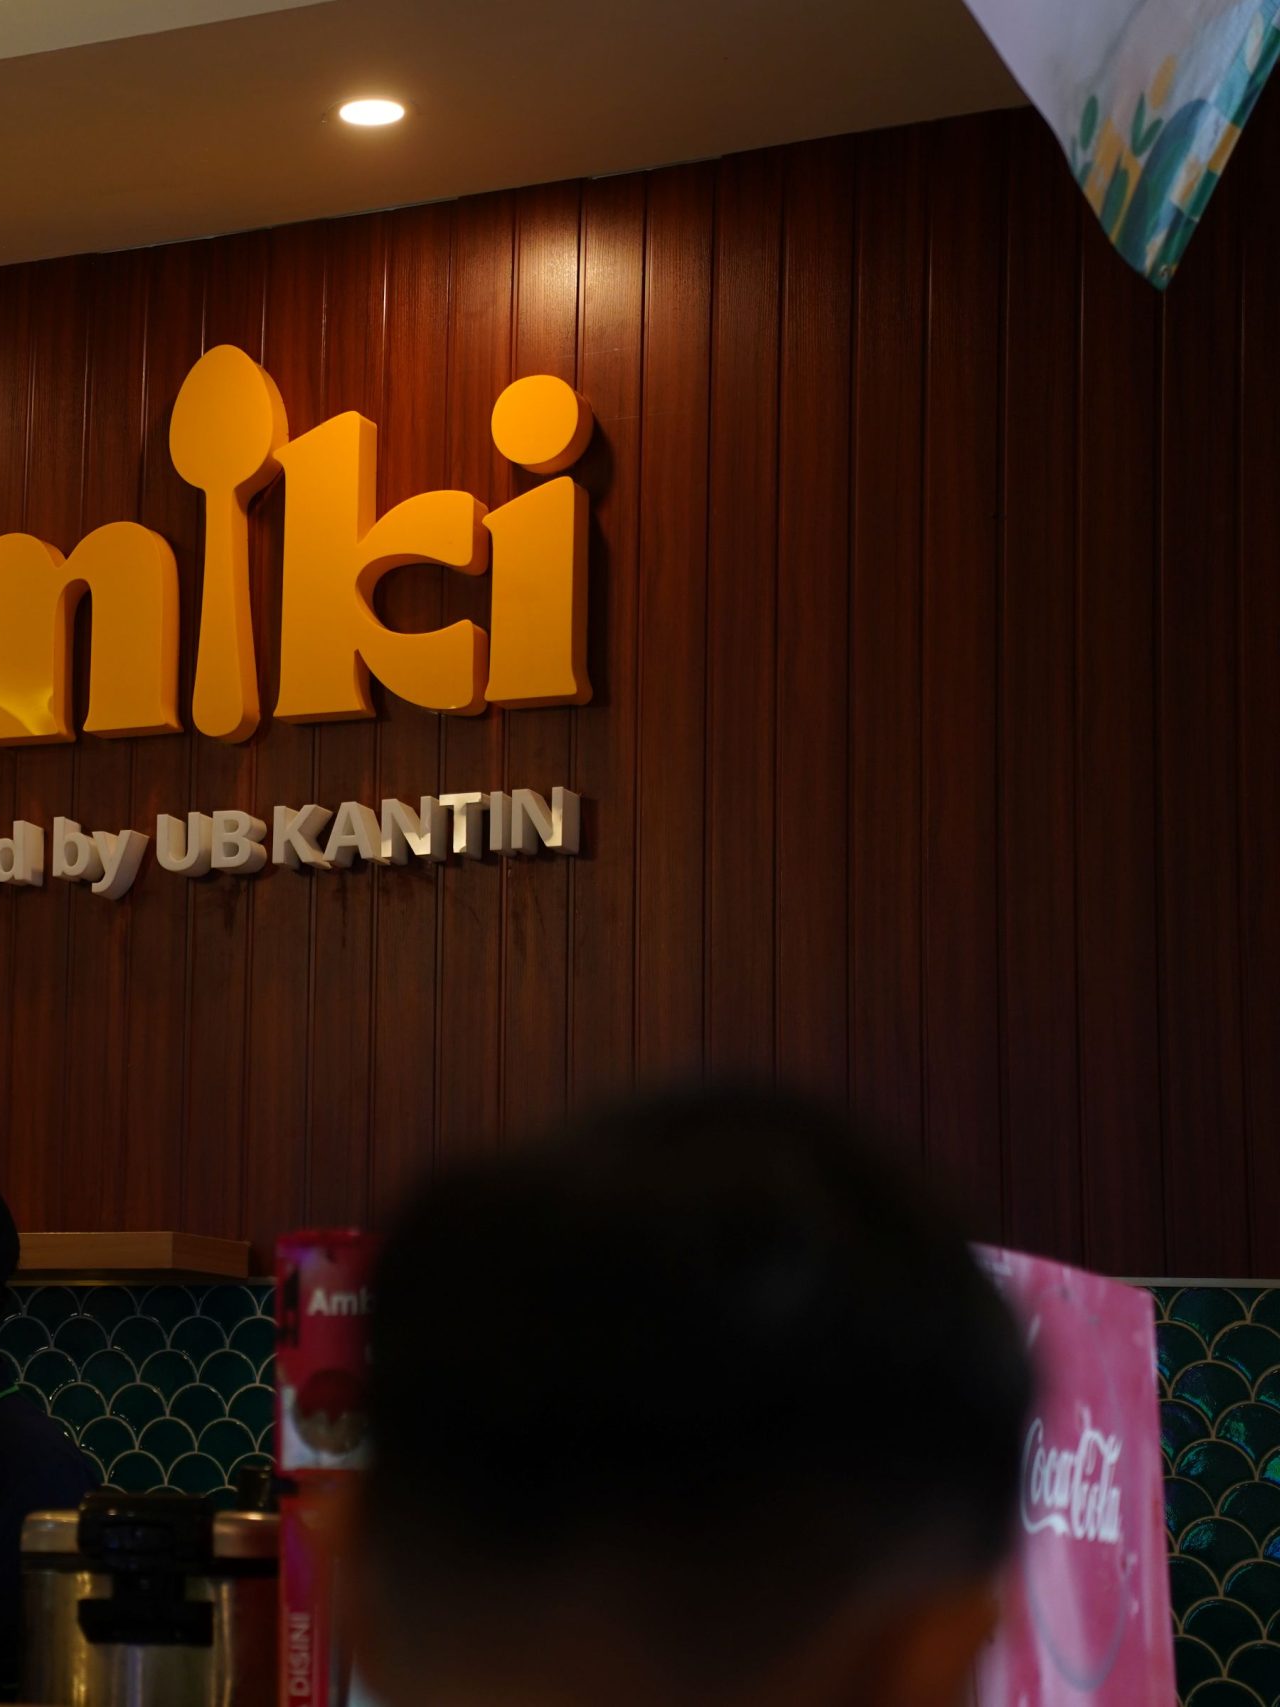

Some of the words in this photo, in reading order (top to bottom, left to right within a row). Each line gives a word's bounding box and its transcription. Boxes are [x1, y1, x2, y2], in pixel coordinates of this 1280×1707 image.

[52, 816, 140, 900] by
[156, 809, 268, 878] UB
[272, 786, 581, 871] KANTIN
